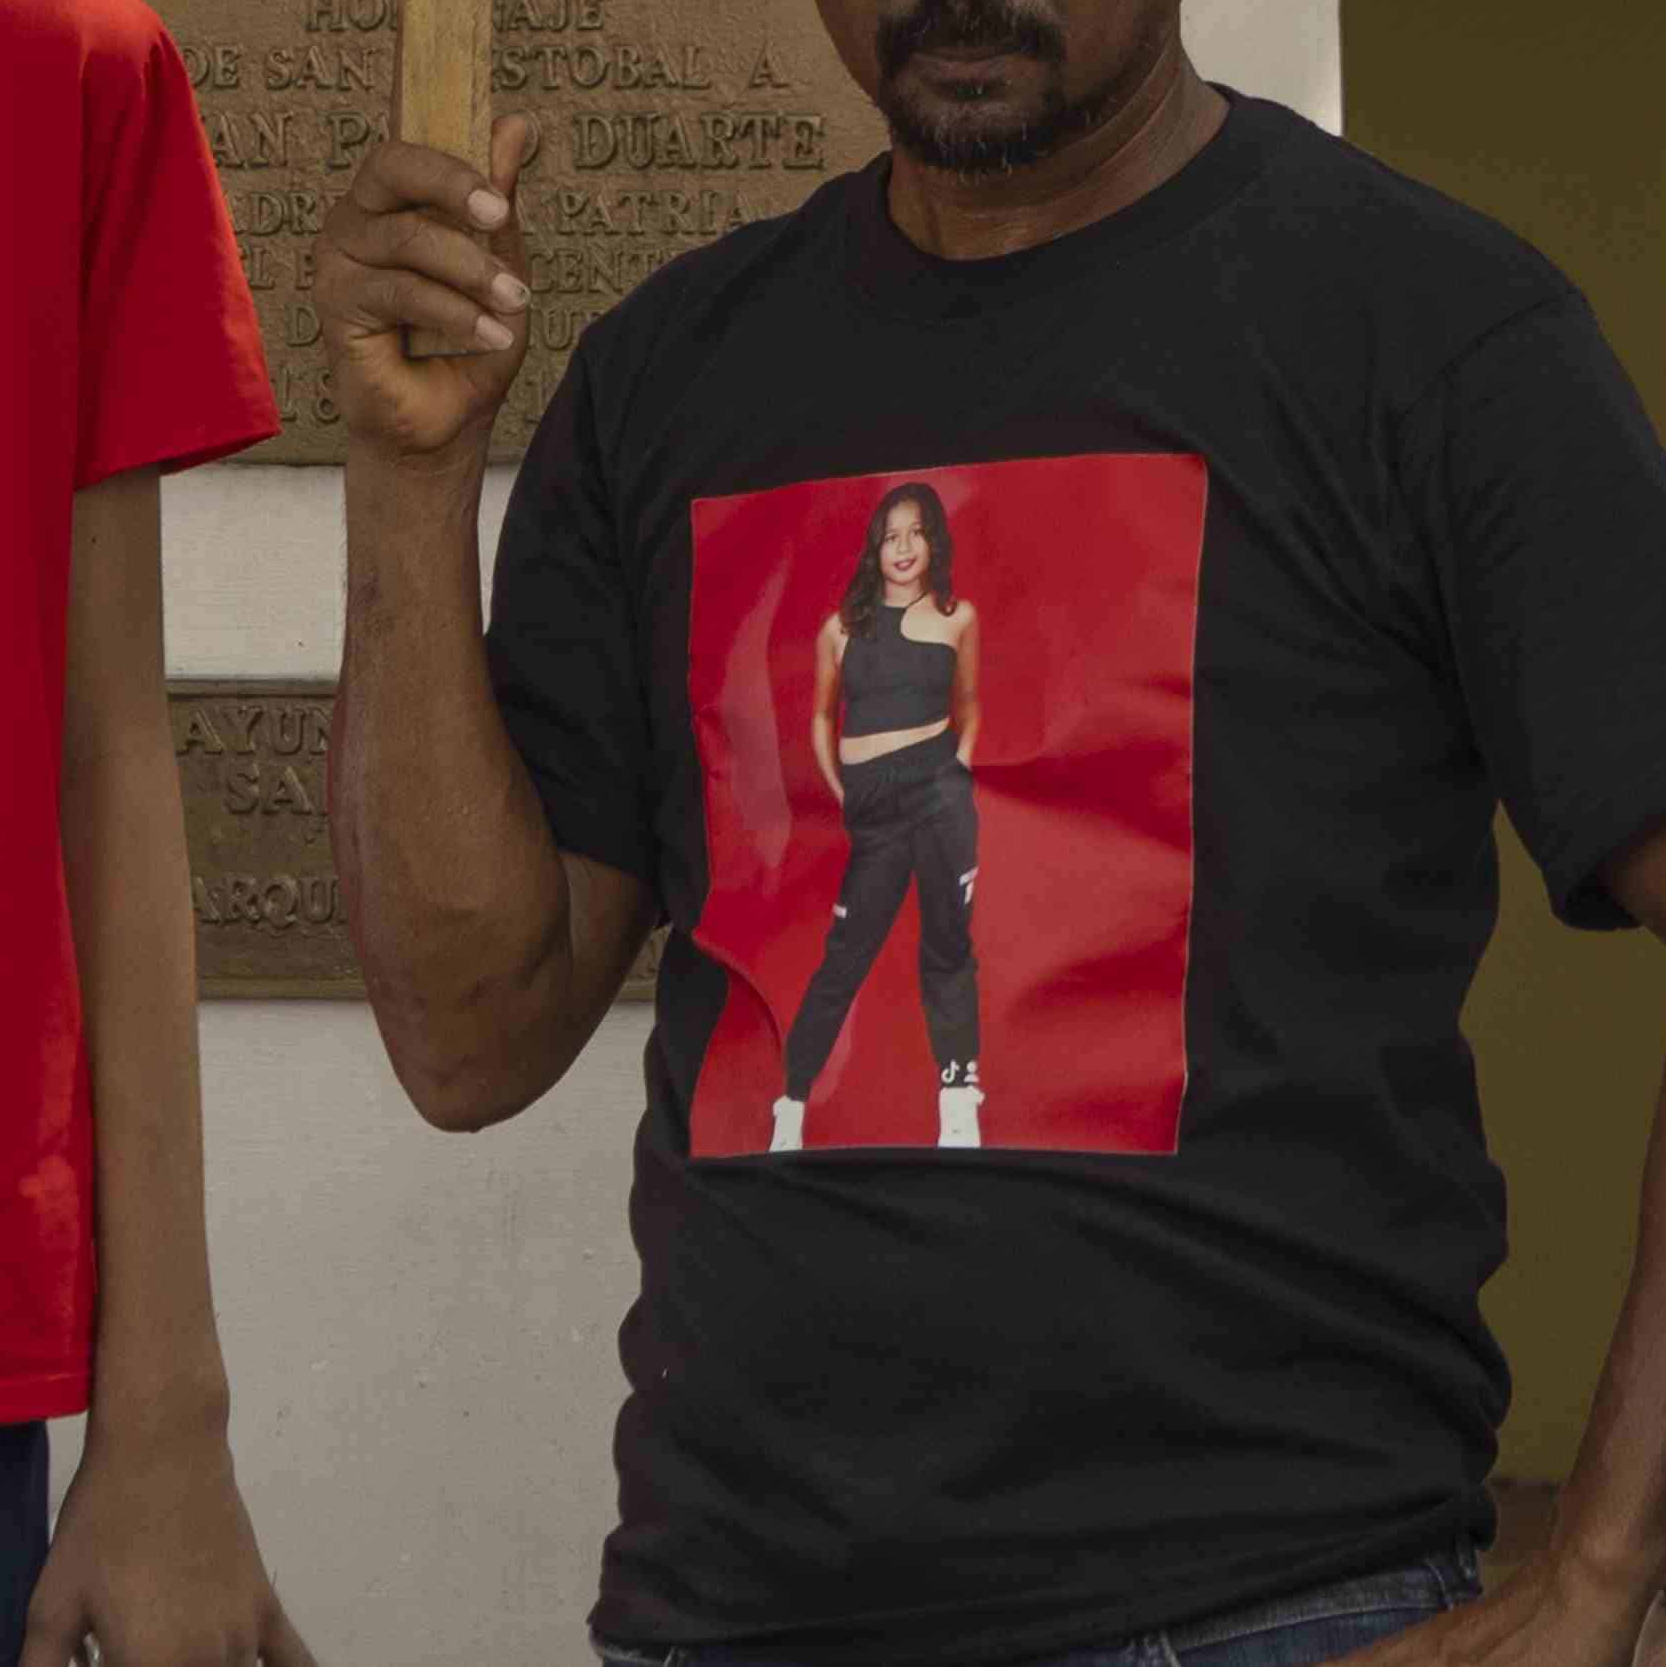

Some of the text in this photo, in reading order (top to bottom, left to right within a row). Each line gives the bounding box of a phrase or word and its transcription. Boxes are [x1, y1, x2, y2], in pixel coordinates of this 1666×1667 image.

[266, 42, 378, 91] SAN
[746, 40, 790, 90] A
[572, 108, 826, 173] DUARTE
[224, 765, 331, 816] SA
